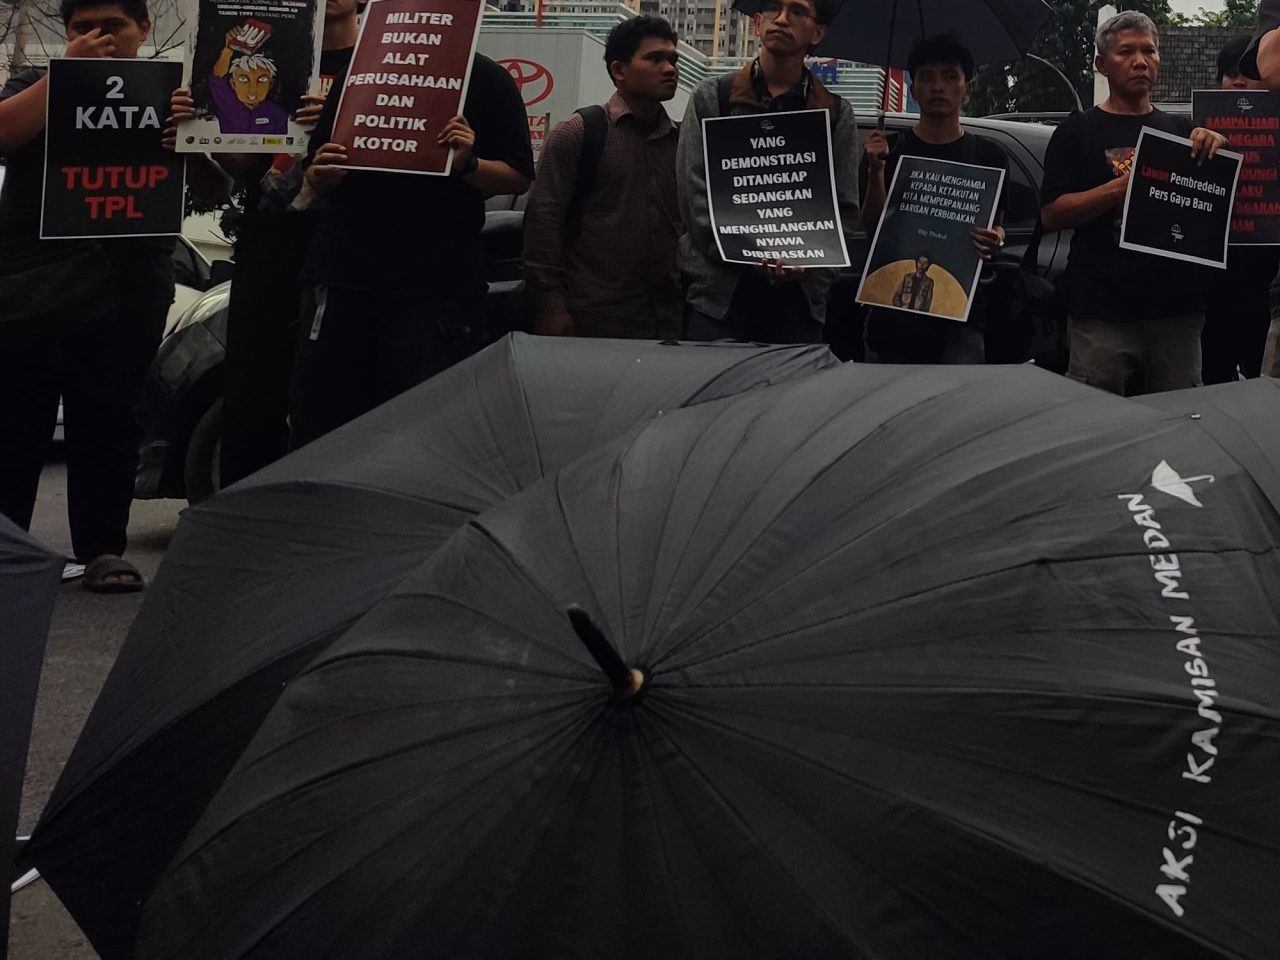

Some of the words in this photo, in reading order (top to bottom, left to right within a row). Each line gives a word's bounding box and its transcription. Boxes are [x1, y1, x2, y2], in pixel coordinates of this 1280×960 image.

[385, 12, 454, 26] MILITER
[381, 32, 442, 46] BUKAN
[382, 52, 429, 66] ALAT
[105, 75, 125, 99] 2
[347, 72, 463, 91] PERUSAHAAN
[375, 93, 415, 108] DAN
[74, 106, 161, 129] KATA
[353, 114, 428, 131] POLITIK
[352, 136, 419, 153] KOTOR
[749, 135, 786, 150] YANG
[1228, 133, 1276, 146] NEGARA
[721, 151, 817, 170] DEMONSTRASI
[61, 166, 169, 191] TUTUP
[733, 170, 808, 188] DITANGKAP
[909, 170, 924, 180] JIKA
[925, 172, 941, 182] KAU
[940, 174, 986, 191] MENGHAMBA
[1169, 172, 1226, 197] Pembredelan
[731, 188, 813, 205] SEDANGKAN
[910, 181, 937, 193] KEPADA
[938, 185, 980, 201] KETAKUTAN
[1149, 186, 1169, 201] Pers
[1169, 191, 1191, 208] Gaya
[1192, 197, 1213, 212] Baru
[84, 195, 144, 220] TPL
[899, 202, 929, 216] BARISAN
[902, 191, 918, 201] KITA
[919, 193, 981, 213] MEMPERPANJANG
[756, 206, 793, 219] YANG
[719, 220, 835, 234] MENGHILANGKAN
[755, 236, 805, 247] NYAWA
[742, 249, 825, 259] DIBEBASKAN
[1117, 492, 1190, 601] MEDAN
[1169, 613, 1223, 784] KAMISAN
[1155, 810, 1203, 918] AKSI
